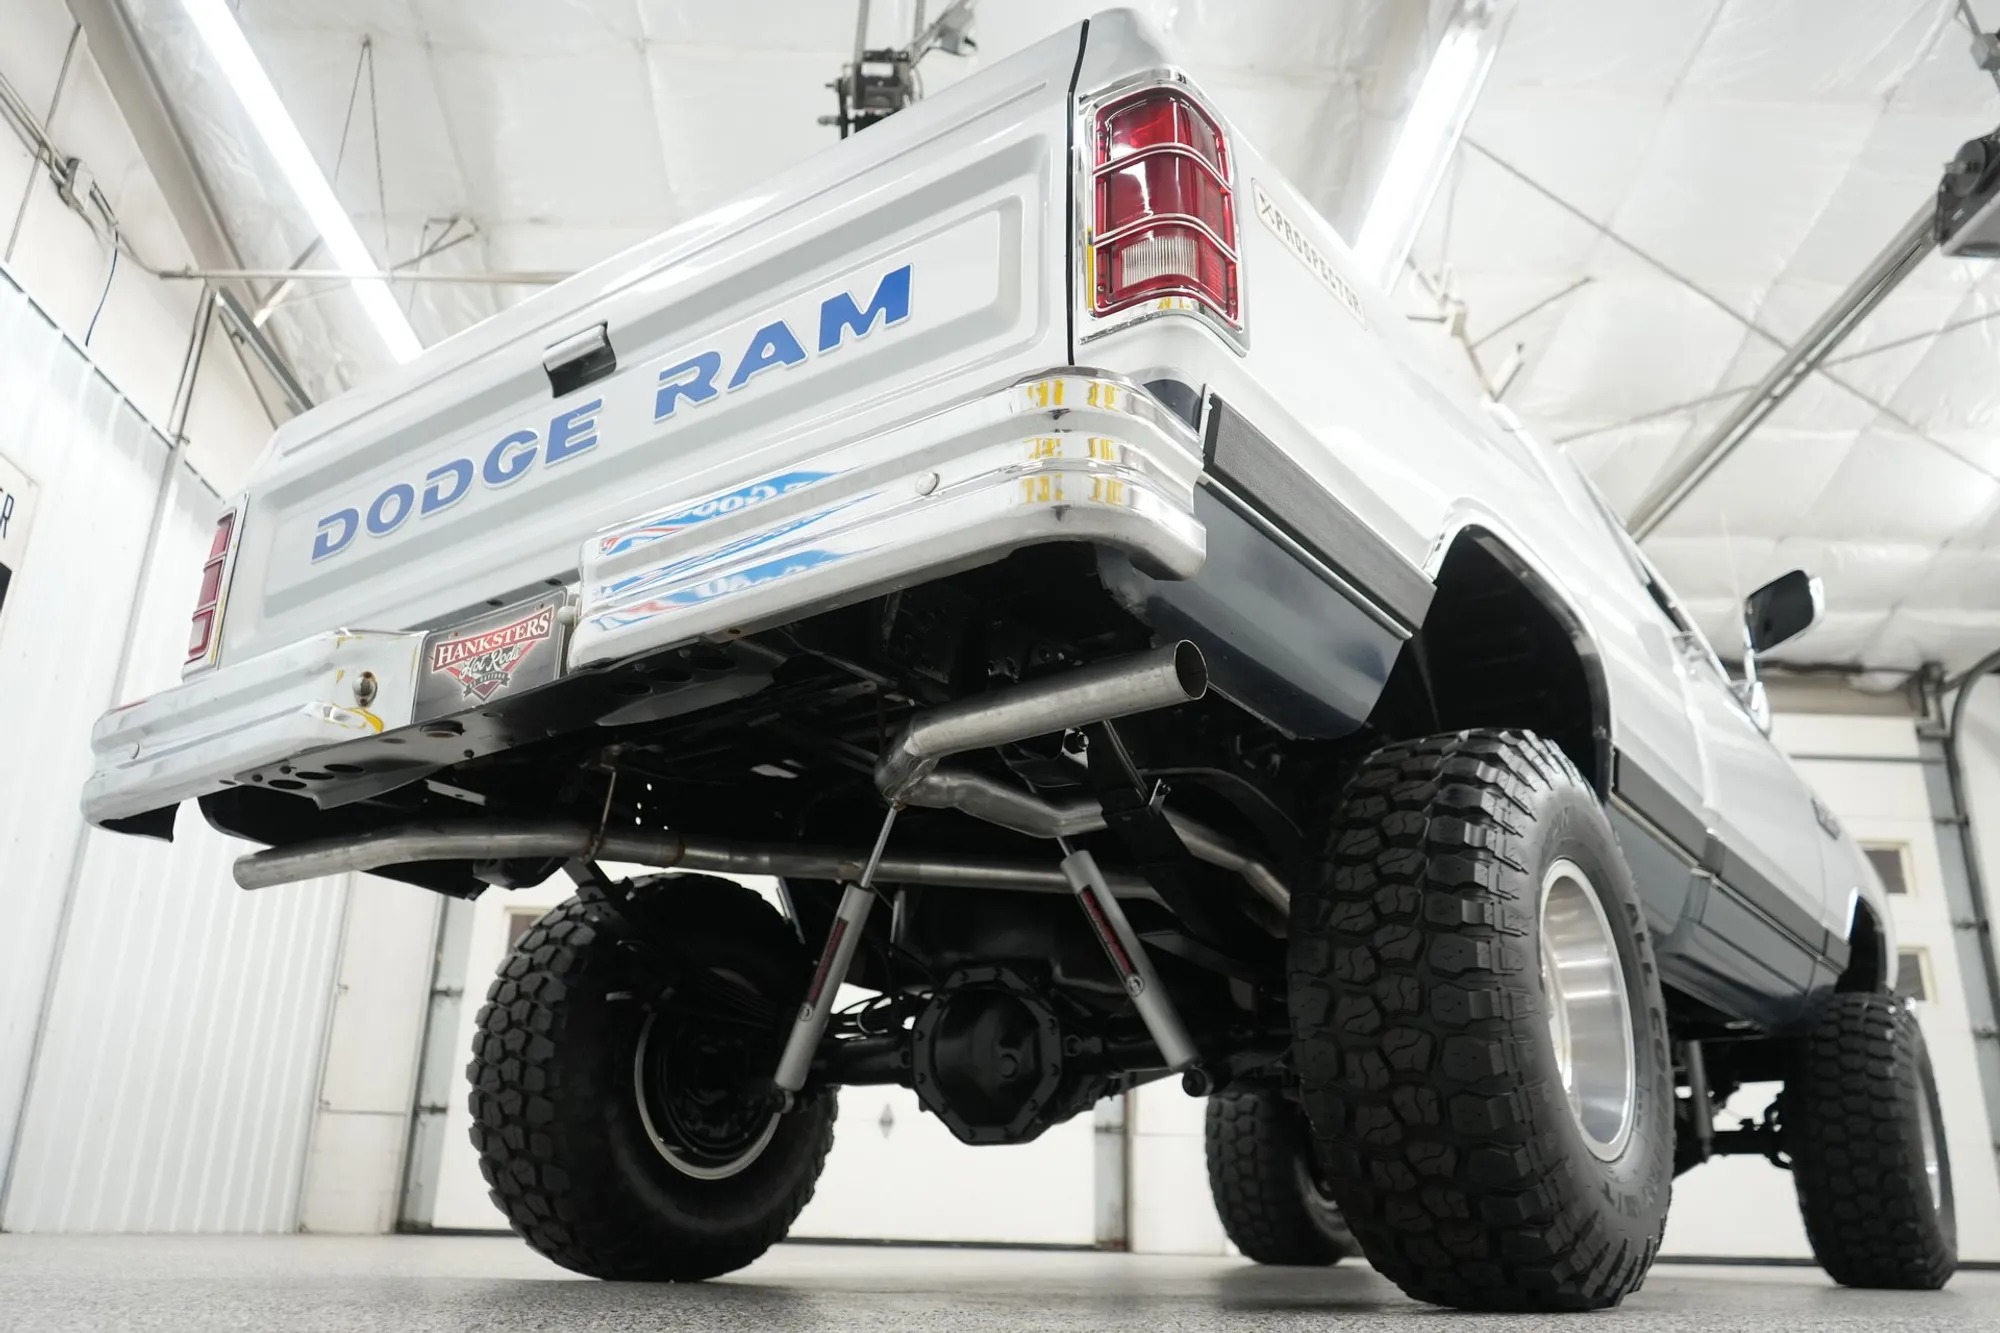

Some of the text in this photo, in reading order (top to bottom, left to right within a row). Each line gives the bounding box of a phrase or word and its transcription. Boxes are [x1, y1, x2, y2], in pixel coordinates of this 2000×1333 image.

[1275, 209, 1362, 315] PROSPECTOR
[311, 262, 914, 564] DODGE RAM
[437, 611, 550, 667] HANKSTERS
[459, 644, 521, 680] Hot Rods
